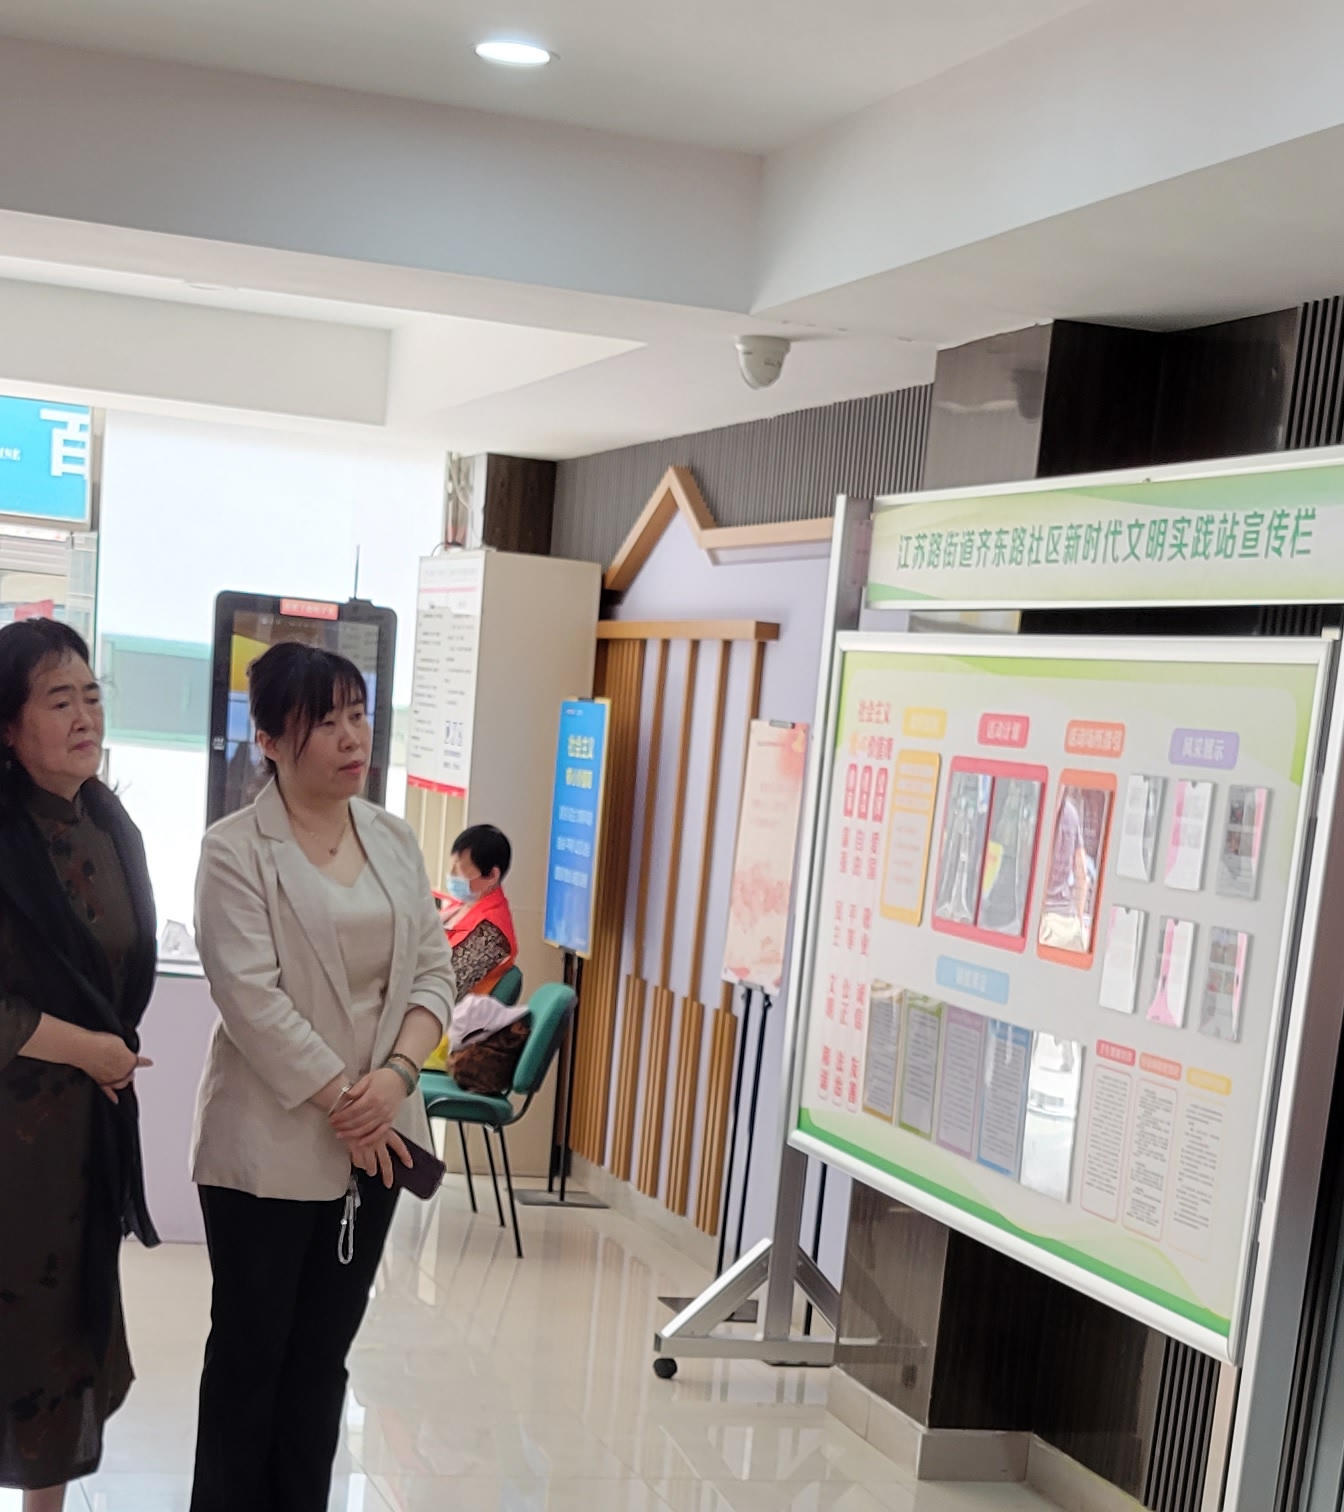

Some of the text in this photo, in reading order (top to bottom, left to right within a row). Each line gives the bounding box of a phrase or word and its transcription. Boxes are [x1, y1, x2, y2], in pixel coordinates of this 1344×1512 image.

[895, 506, 1317, 570] 江苏路街道齐东路社区新时代文明实践站宣传栏
